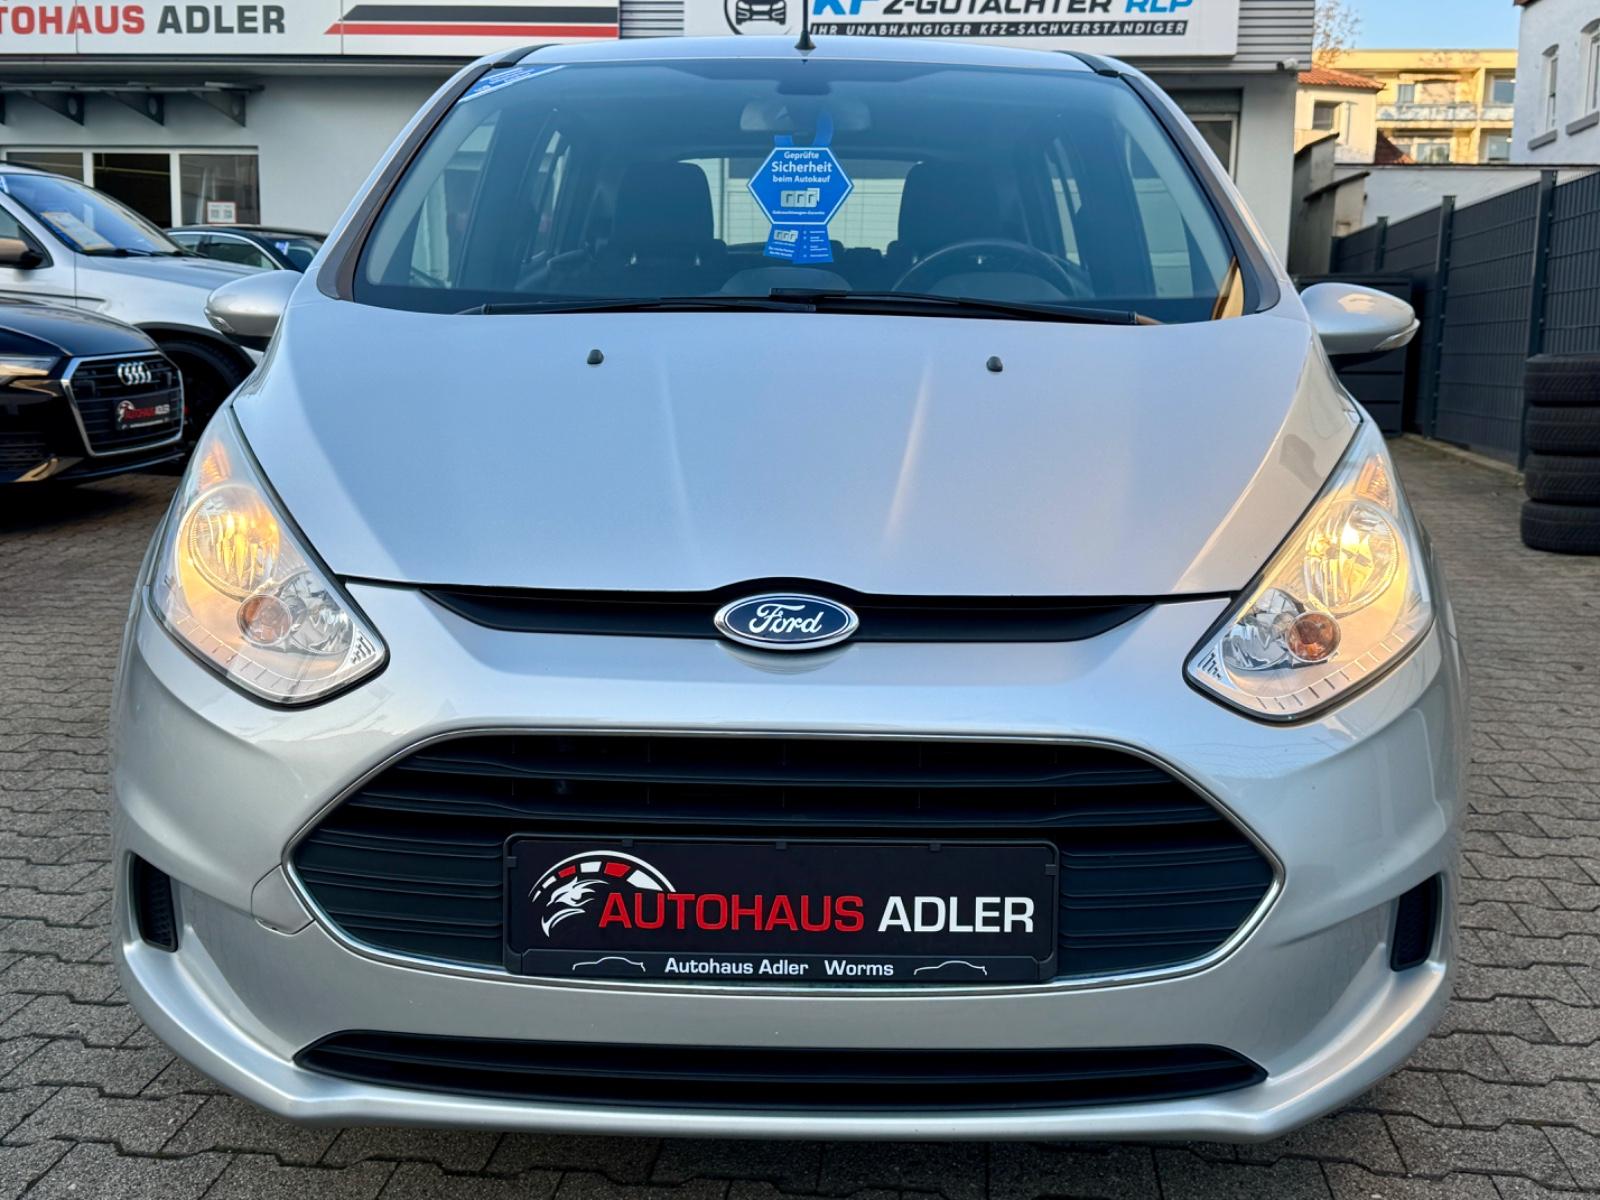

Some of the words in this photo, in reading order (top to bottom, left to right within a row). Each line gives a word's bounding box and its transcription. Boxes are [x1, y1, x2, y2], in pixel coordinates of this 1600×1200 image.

[1124, 0, 1194, 14] RLP
[157, 5, 286, 34] ADLER
[811, 24, 838, 35] IHR
[845, 22, 972, 36] UNABHÄNGIGER
[979, 21, 1186, 35] KFZ-SACHVERSTÄNDIGER
[783, 150, 820, 160] Geprüfte
[771, 160, 832, 172] Sicherheit
[772, 174, 793, 183] beim
[794, 174, 831, 183] Autokauf
[749, 603, 825, 633] Ford
[598, 892, 865, 932] AUTOHAUS
[877, 895, 1035, 934] ADLER
[664, 957, 754, 975] Autohaus
[758, 958, 809, 976] Adler
[824, 959, 894, 977] Worms
